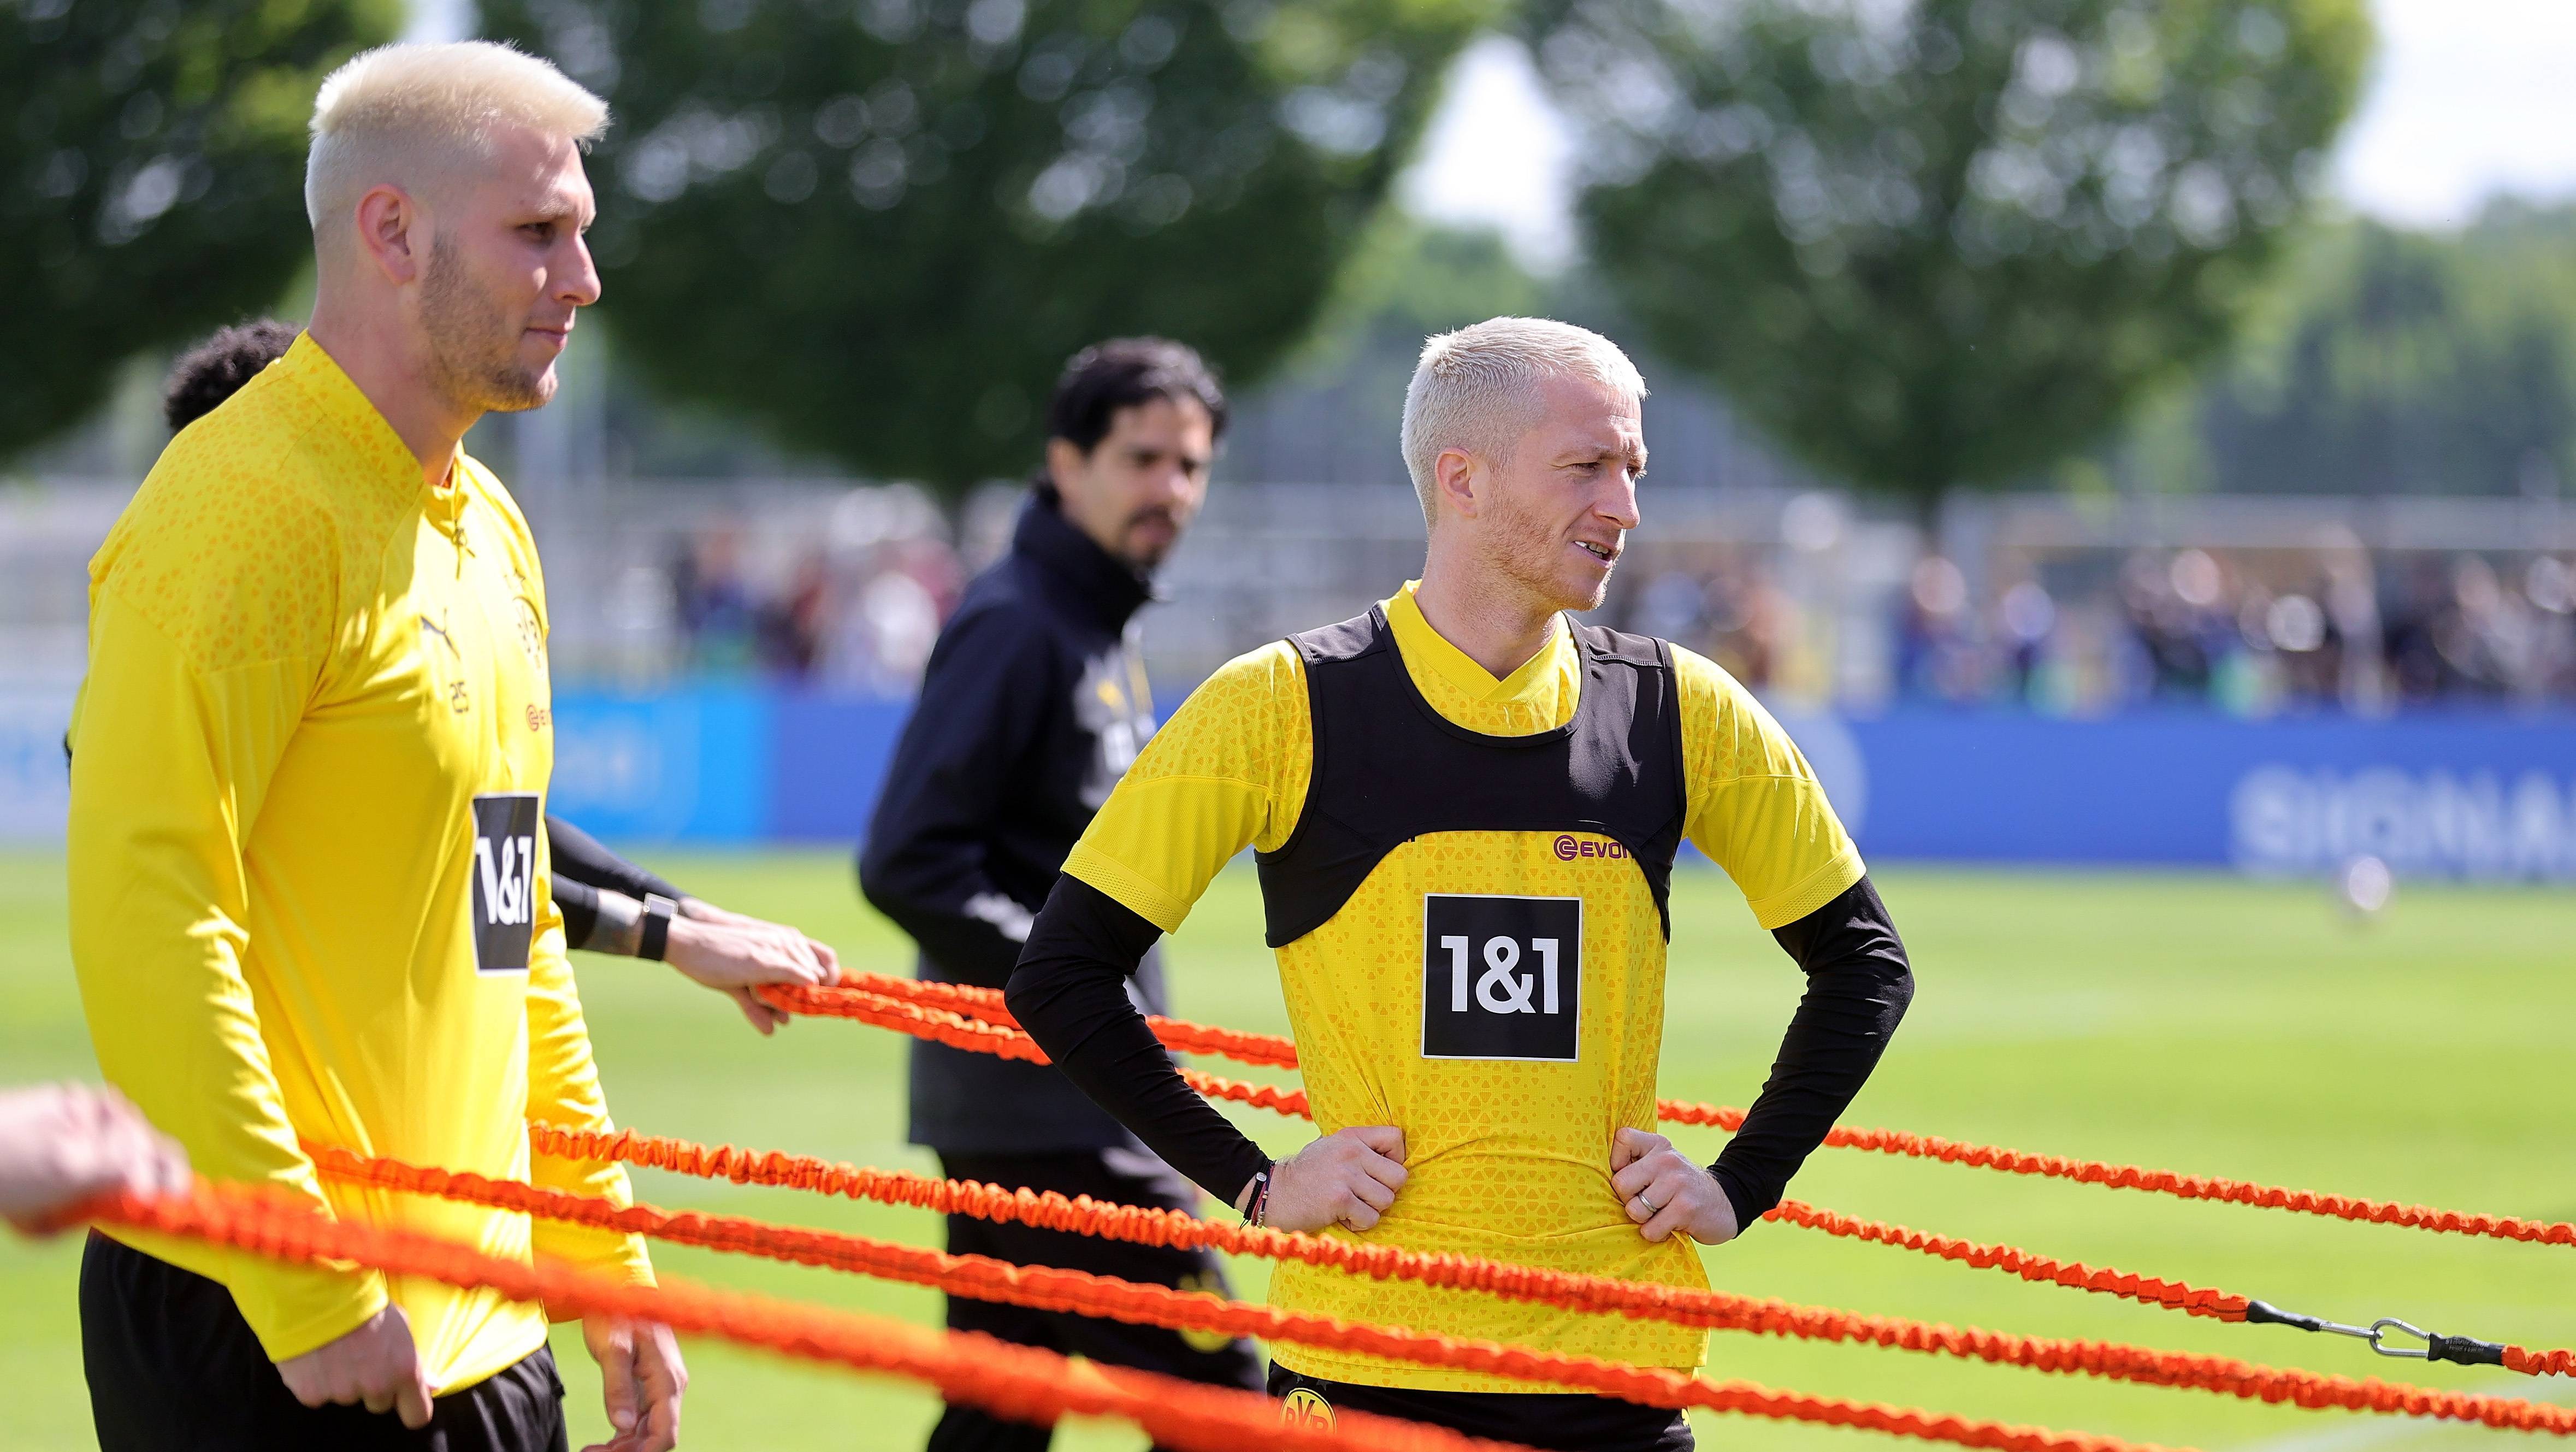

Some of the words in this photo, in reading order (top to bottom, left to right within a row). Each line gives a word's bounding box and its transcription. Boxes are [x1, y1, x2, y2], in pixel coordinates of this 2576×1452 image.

[2230, 765, 2576, 870] SIGNA
[476, 835, 533, 925] 1&1
[1441, 935, 1559, 1014] 1&1
